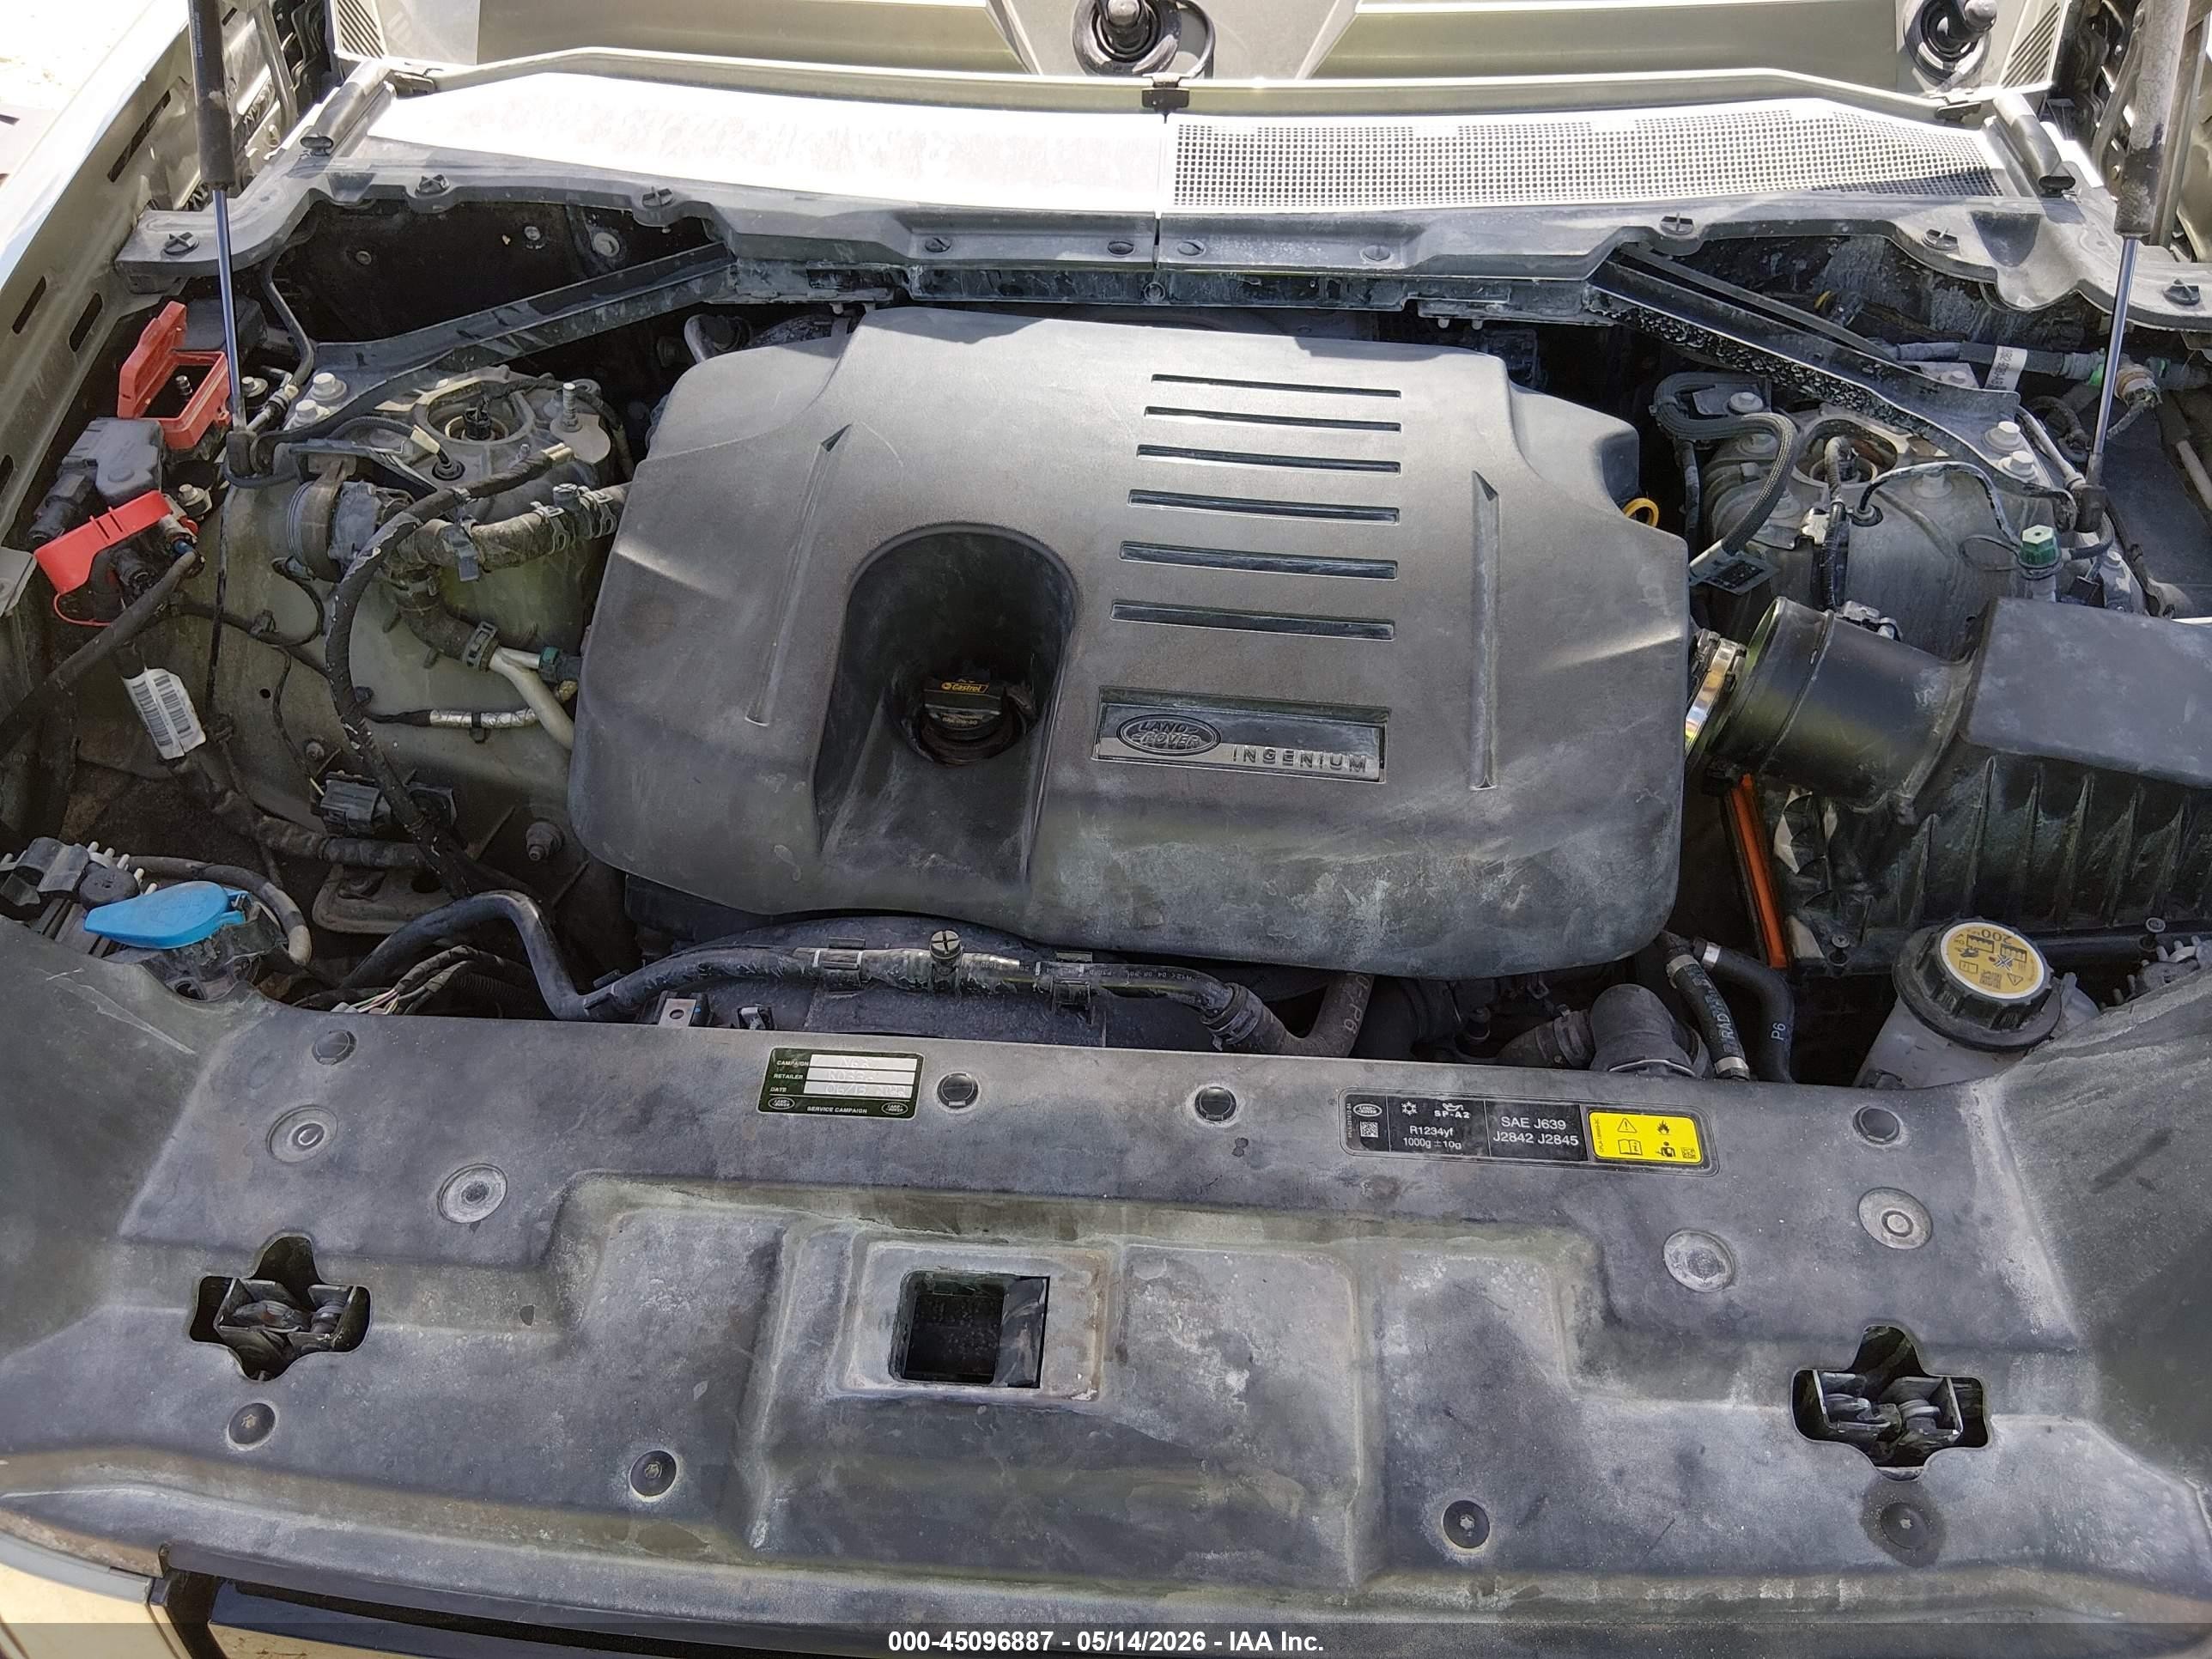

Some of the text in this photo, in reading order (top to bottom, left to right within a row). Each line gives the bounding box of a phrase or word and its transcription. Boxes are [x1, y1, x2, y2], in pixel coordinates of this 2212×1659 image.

[951, 684, 981, 692] Castrol
[1138, 720, 1188, 733] LAND
[1139, 731, 1202, 750] ROVER
[1231, 744, 1367, 773] INGENIUM
[1771, 1023, 1786, 1041] P6
[1501, 1116, 1566, 1130] SAE J639
[1410, 1126, 1454, 1138] R1234yf
[1493, 1130, 1579, 1146] J2842 J2845
[1403, 1138, 1462, 1150] 1000g ±10g
